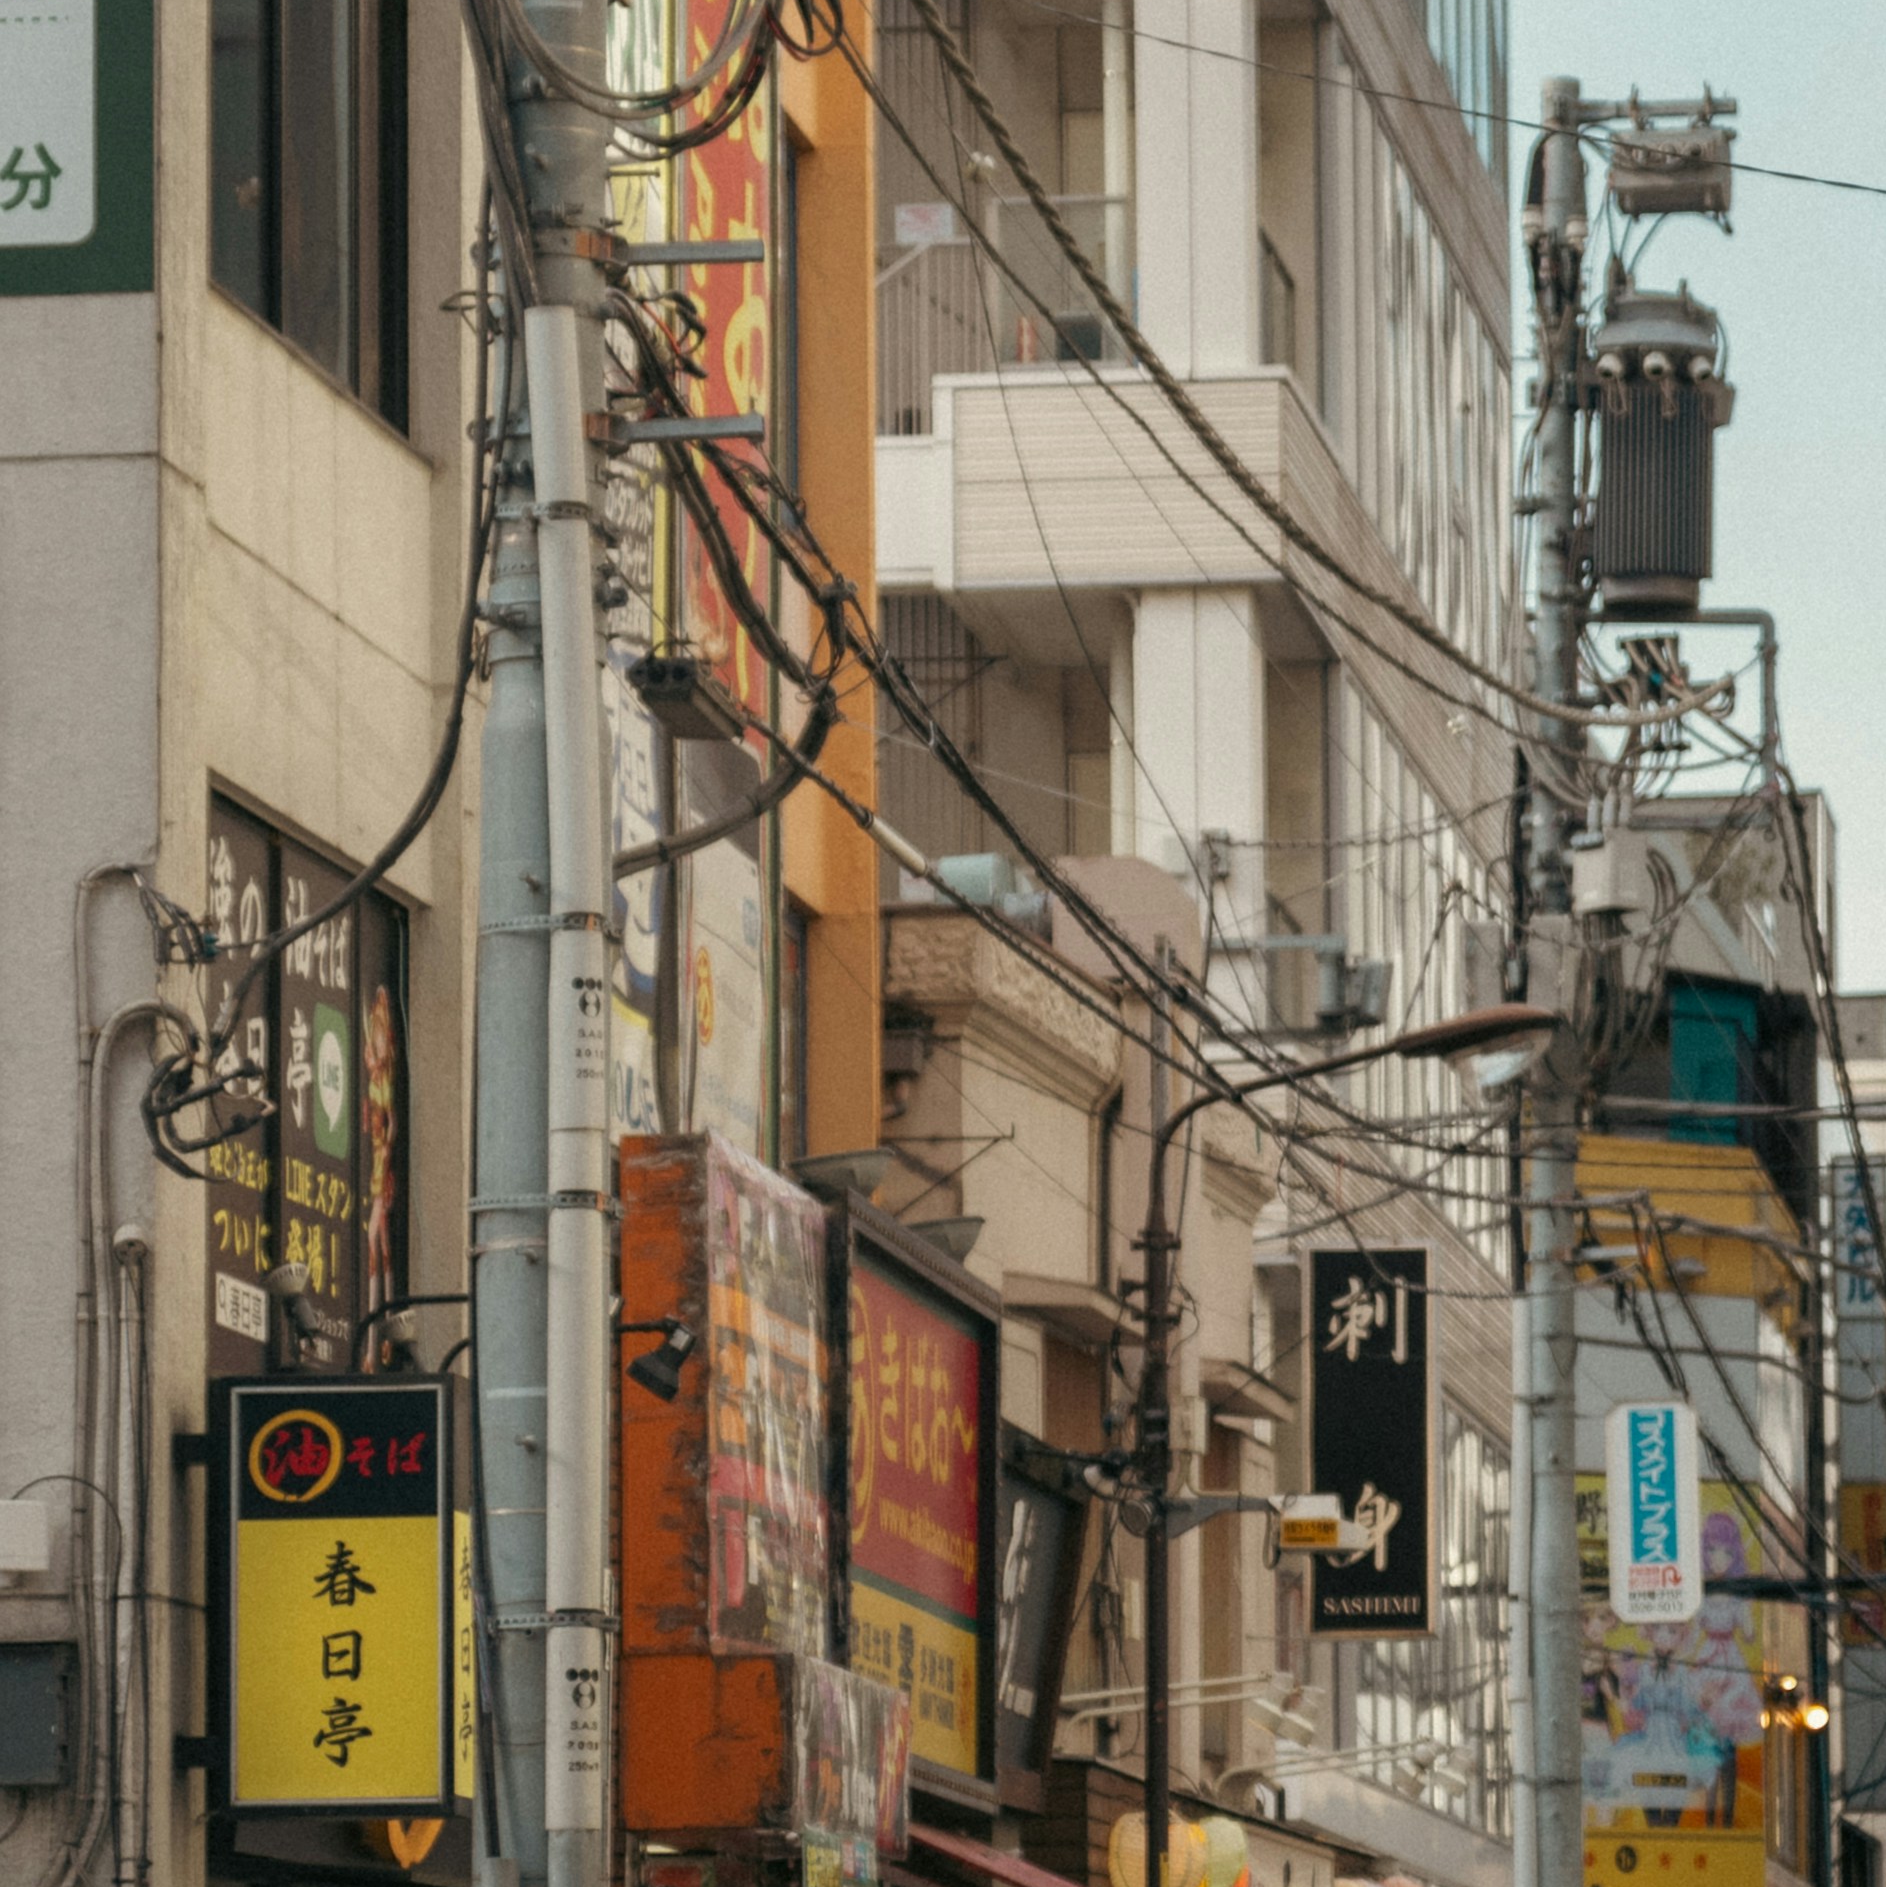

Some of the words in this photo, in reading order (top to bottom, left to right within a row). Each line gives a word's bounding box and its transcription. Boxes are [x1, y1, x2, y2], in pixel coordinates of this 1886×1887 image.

[263, 1426, 427, 1489] 油そば
[1323, 1596, 1421, 1616] SASHIMI
[313, 1540, 377, 1769] 春日亭
